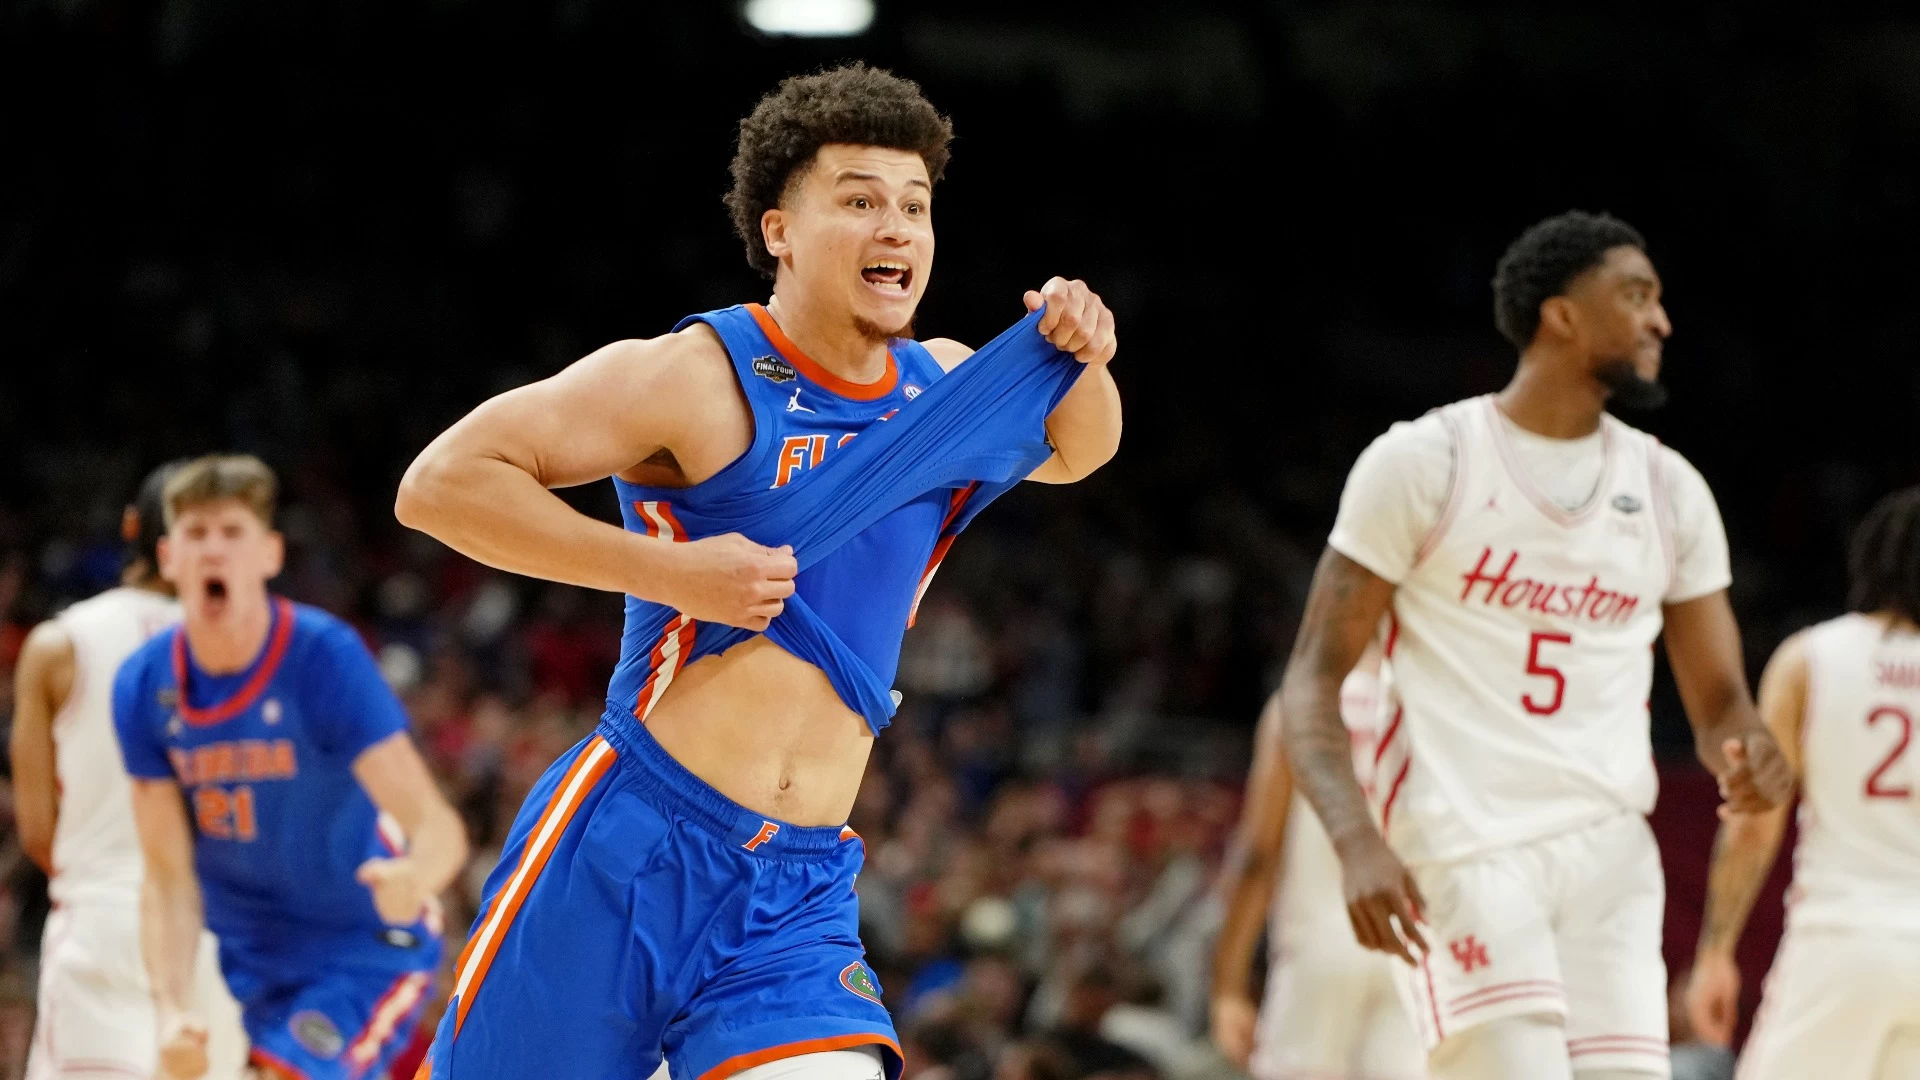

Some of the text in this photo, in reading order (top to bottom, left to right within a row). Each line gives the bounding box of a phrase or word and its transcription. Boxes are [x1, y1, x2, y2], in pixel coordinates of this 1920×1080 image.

[756, 362, 794, 376] FINAL FOUR
[1459, 545, 1639, 624] Houston
[1521, 632, 1572, 716] 5
[195, 788, 257, 842] 21
[741, 821, 780, 852] F
